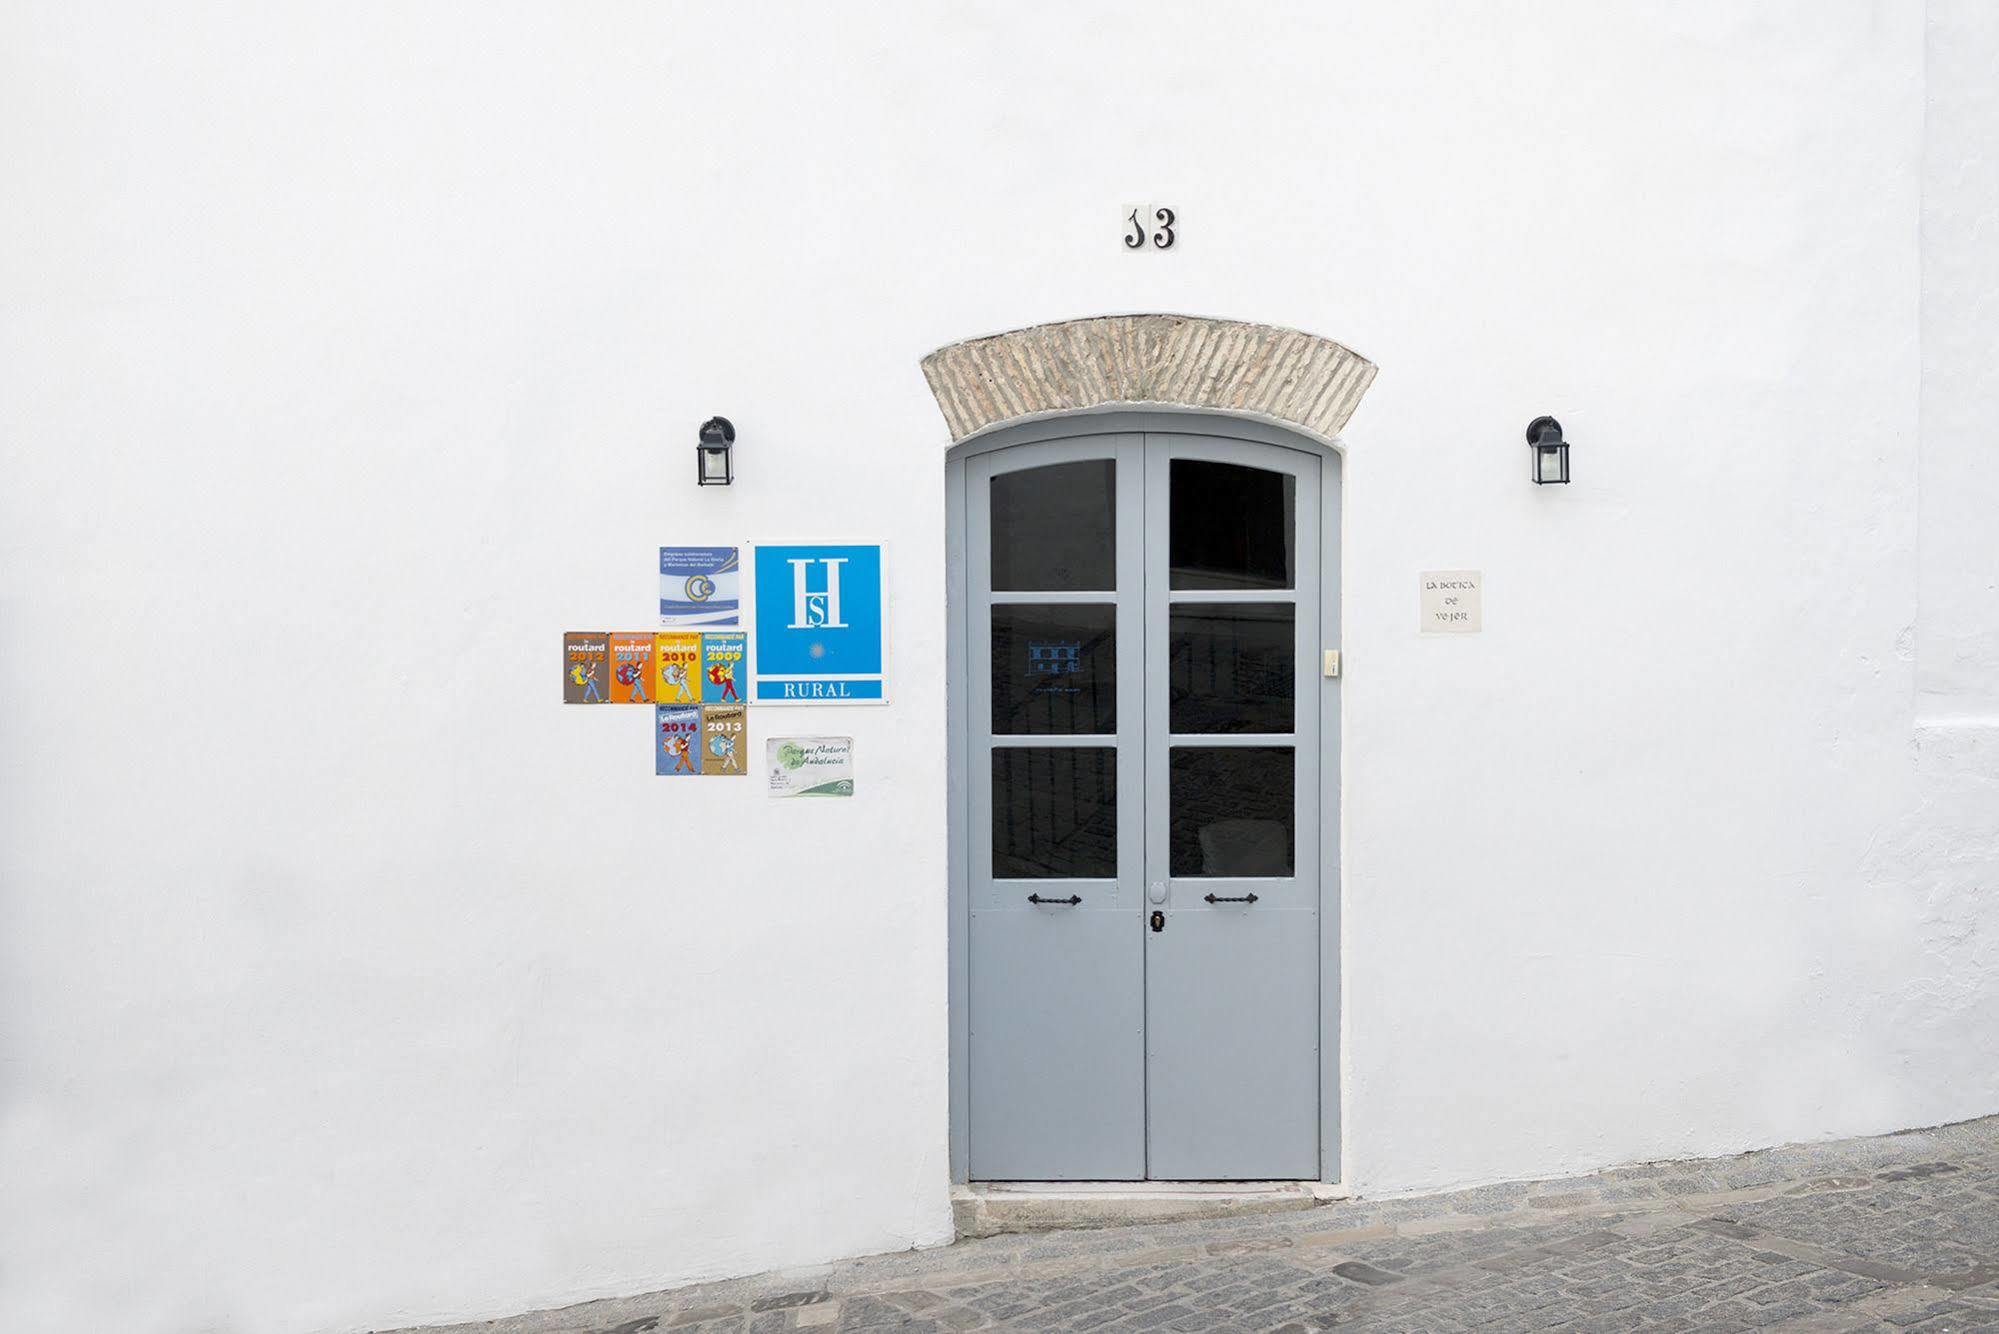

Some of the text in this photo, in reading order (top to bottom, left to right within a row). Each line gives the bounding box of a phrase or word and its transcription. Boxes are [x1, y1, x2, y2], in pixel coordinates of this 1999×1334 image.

[1125, 208, 1175, 249] 13
[1426, 581, 1438, 590] LA
[569, 652, 605, 662] 2012
[617, 652, 649, 661] 2011
[662, 652, 696, 661] 2010
[707, 652, 742, 661] 2009
[784, 682, 850, 698] RURAL
[662, 722, 697, 732] 2014
[707, 722, 742, 732] 2013
